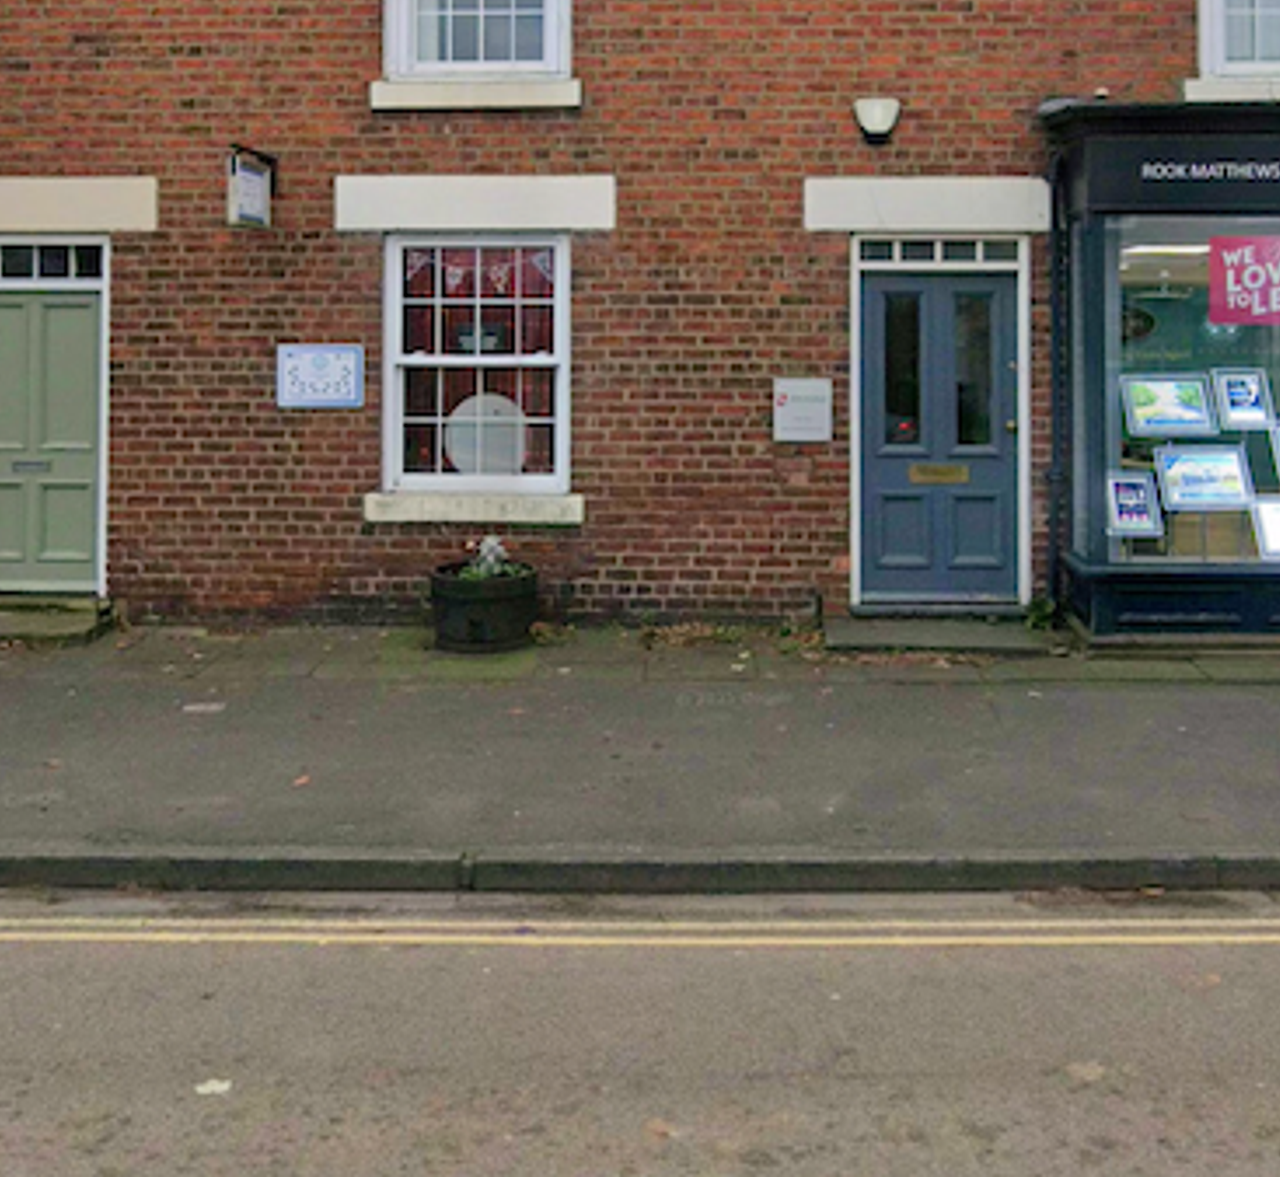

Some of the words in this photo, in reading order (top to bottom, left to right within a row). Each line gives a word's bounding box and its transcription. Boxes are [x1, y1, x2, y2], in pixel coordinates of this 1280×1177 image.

[1141, 163, 1190, 178] ROOK
[1191, 163, 1280, 178] MATTHEWS
[1222, 245, 1255, 267] WE
[1226, 292, 1251, 309] TO
